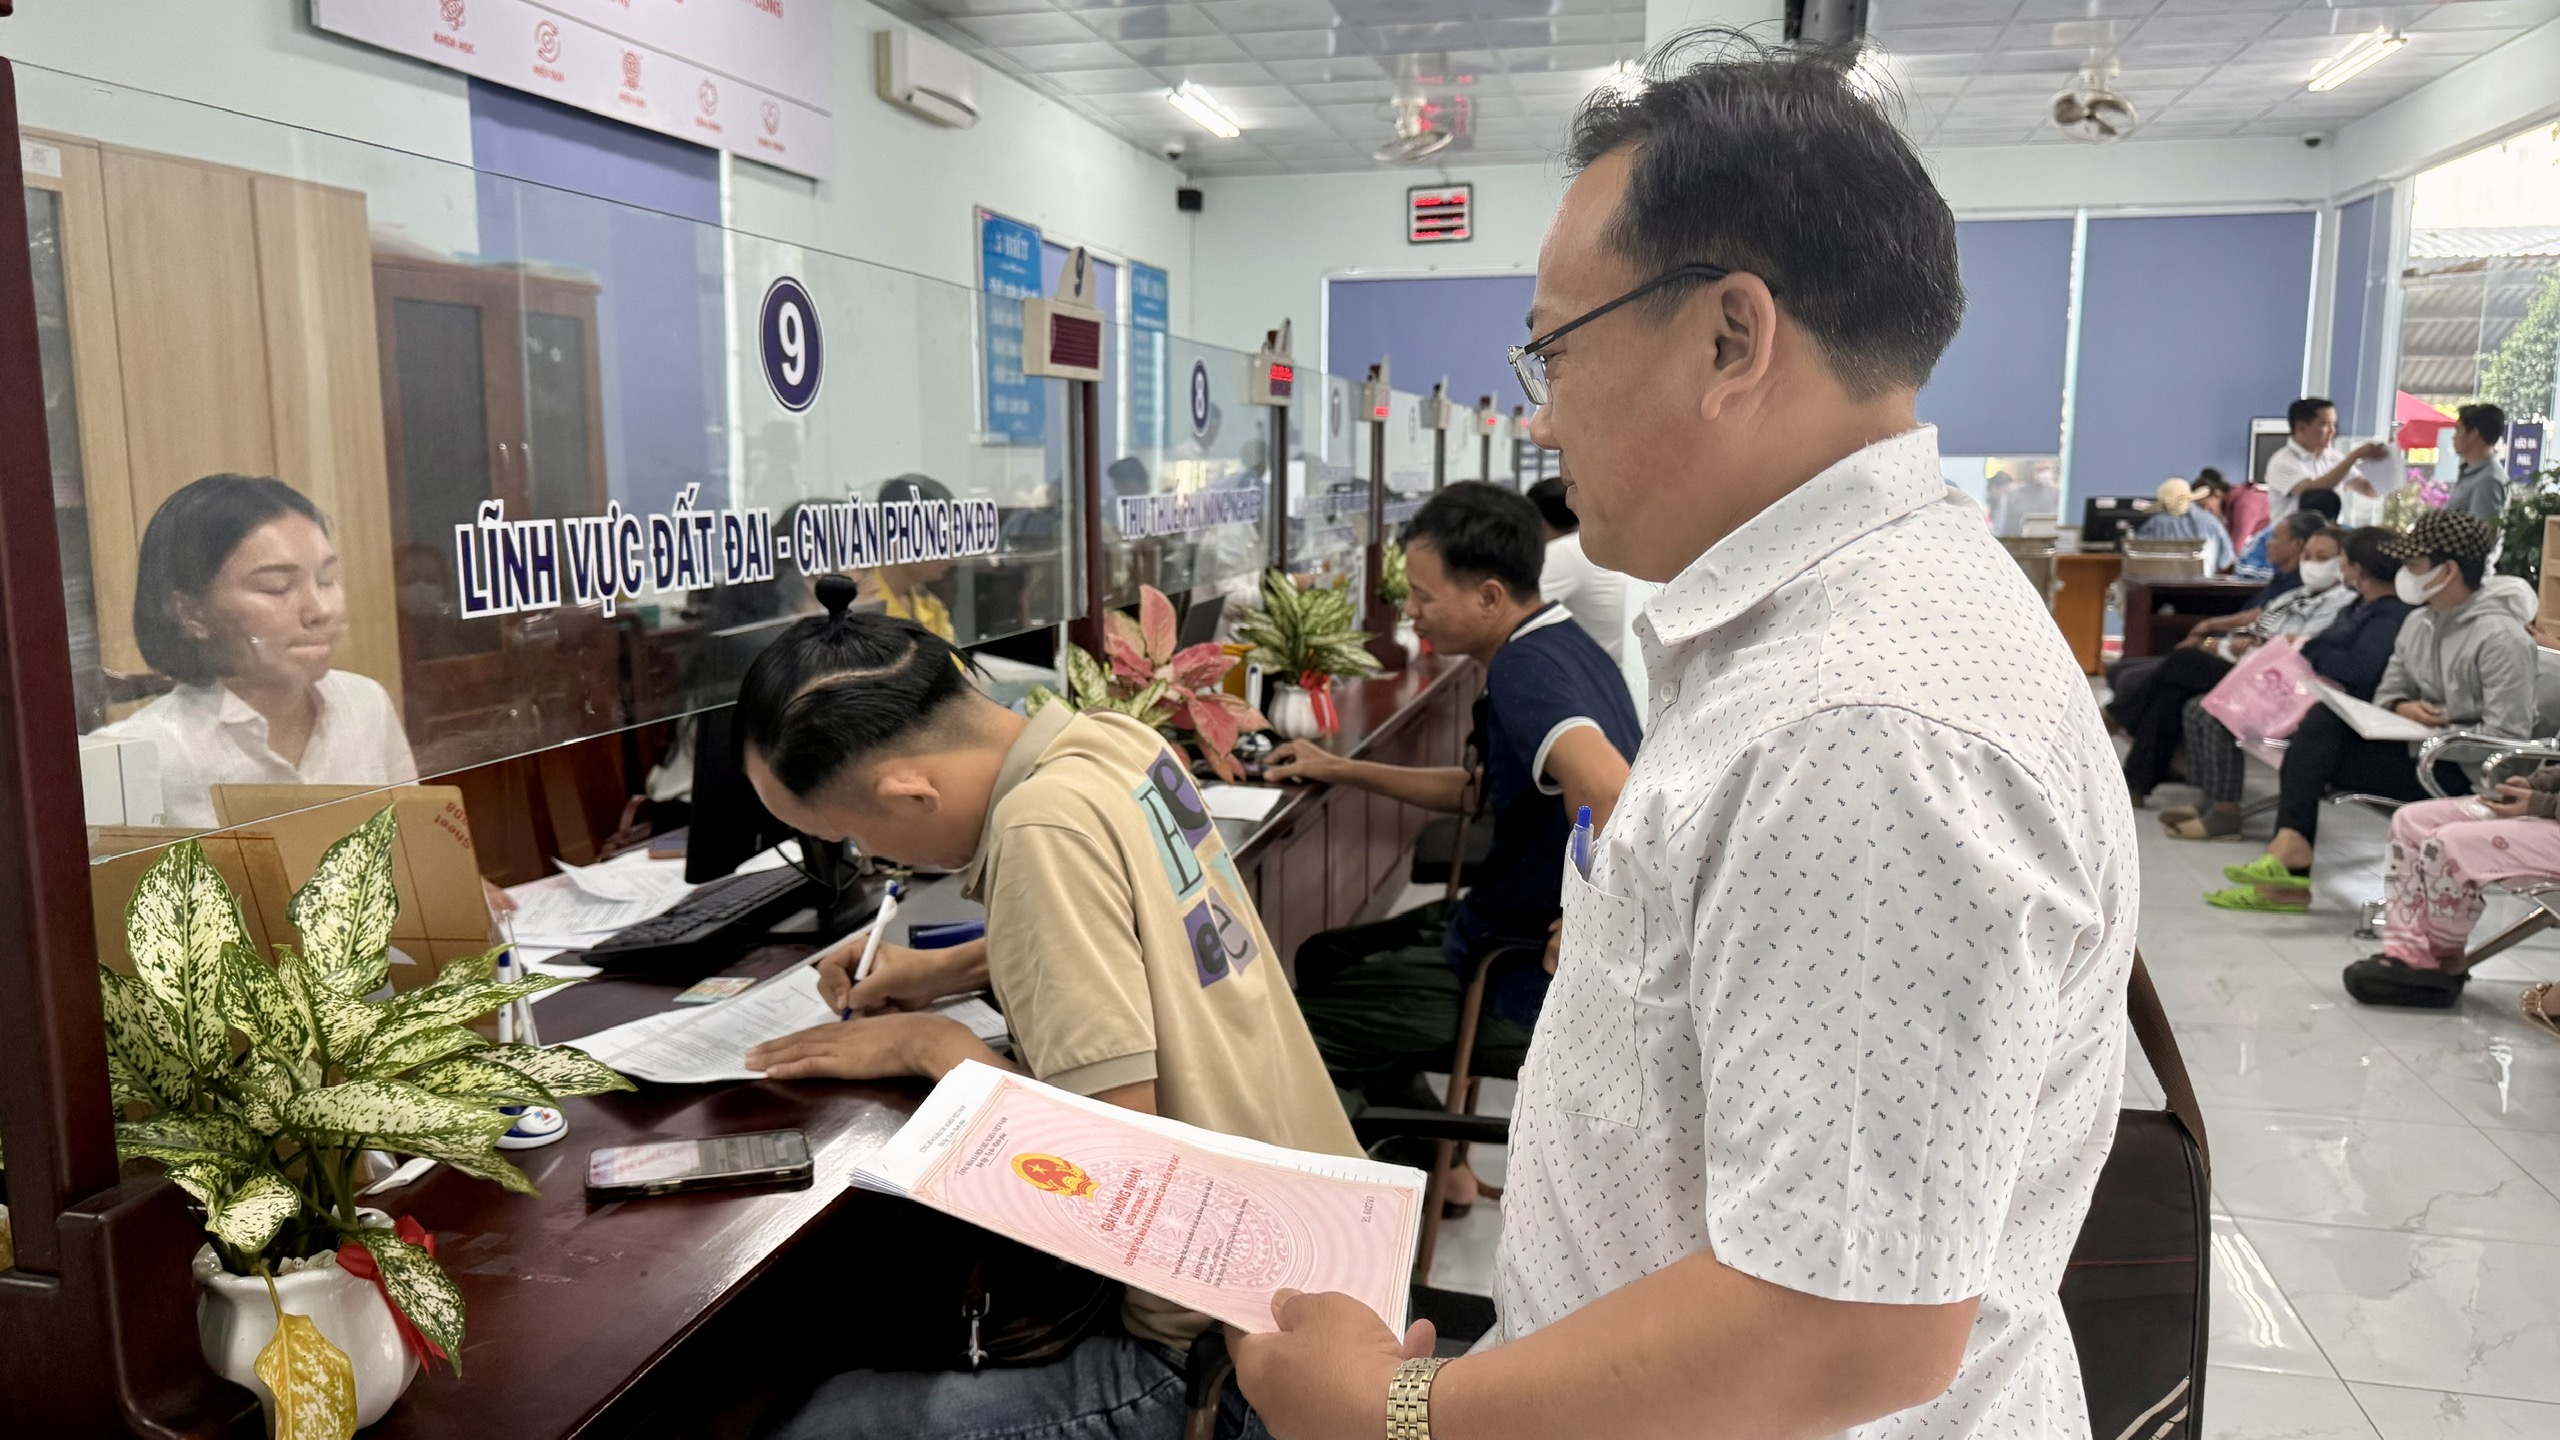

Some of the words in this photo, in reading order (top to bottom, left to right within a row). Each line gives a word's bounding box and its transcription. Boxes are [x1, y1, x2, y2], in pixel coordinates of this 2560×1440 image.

[1074, 246, 1086, 298] 9
[778, 301, 807, 386] 9
[1195, 372, 1205, 420] 8
[454, 498, 562, 619] LĨNH
[564, 500, 644, 618] VỰC
[648, 482, 716, 594] ĐẤT
[722, 507, 773, 586] ĐAI
[793, 502, 832, 577] CN
[833, 492, 882, 572] VĂN
[885, 484, 951, 564] PHÒNG
[950, 498, 998, 556] ĐKĐĐ
[1101, 1213, 1119, 1232] GIẤY
[1110, 1189, 1132, 1215] CHỨNG
